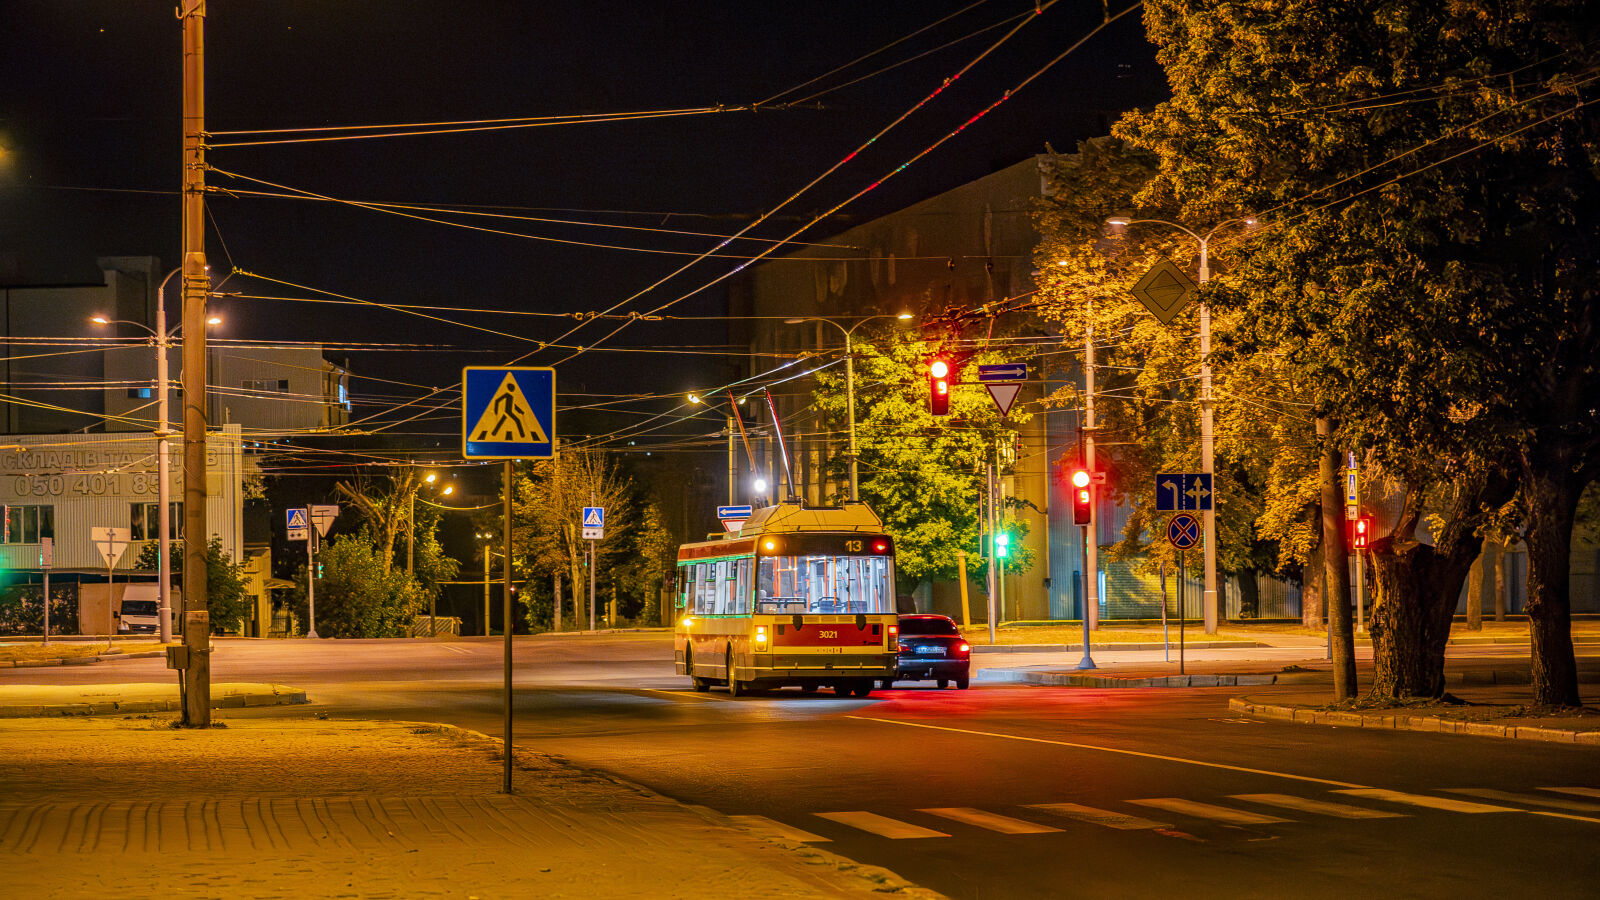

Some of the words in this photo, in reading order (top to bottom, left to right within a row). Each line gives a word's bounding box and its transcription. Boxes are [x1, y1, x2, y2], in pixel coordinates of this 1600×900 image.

[1, 449, 98, 471] СКЛАДІВ
[105, 449, 133, 467] ТА
[14, 474, 65, 497] 050
[73, 474, 121, 496] 401
[845, 540, 862, 552] 13
[818, 630, 838, 639] 3021
